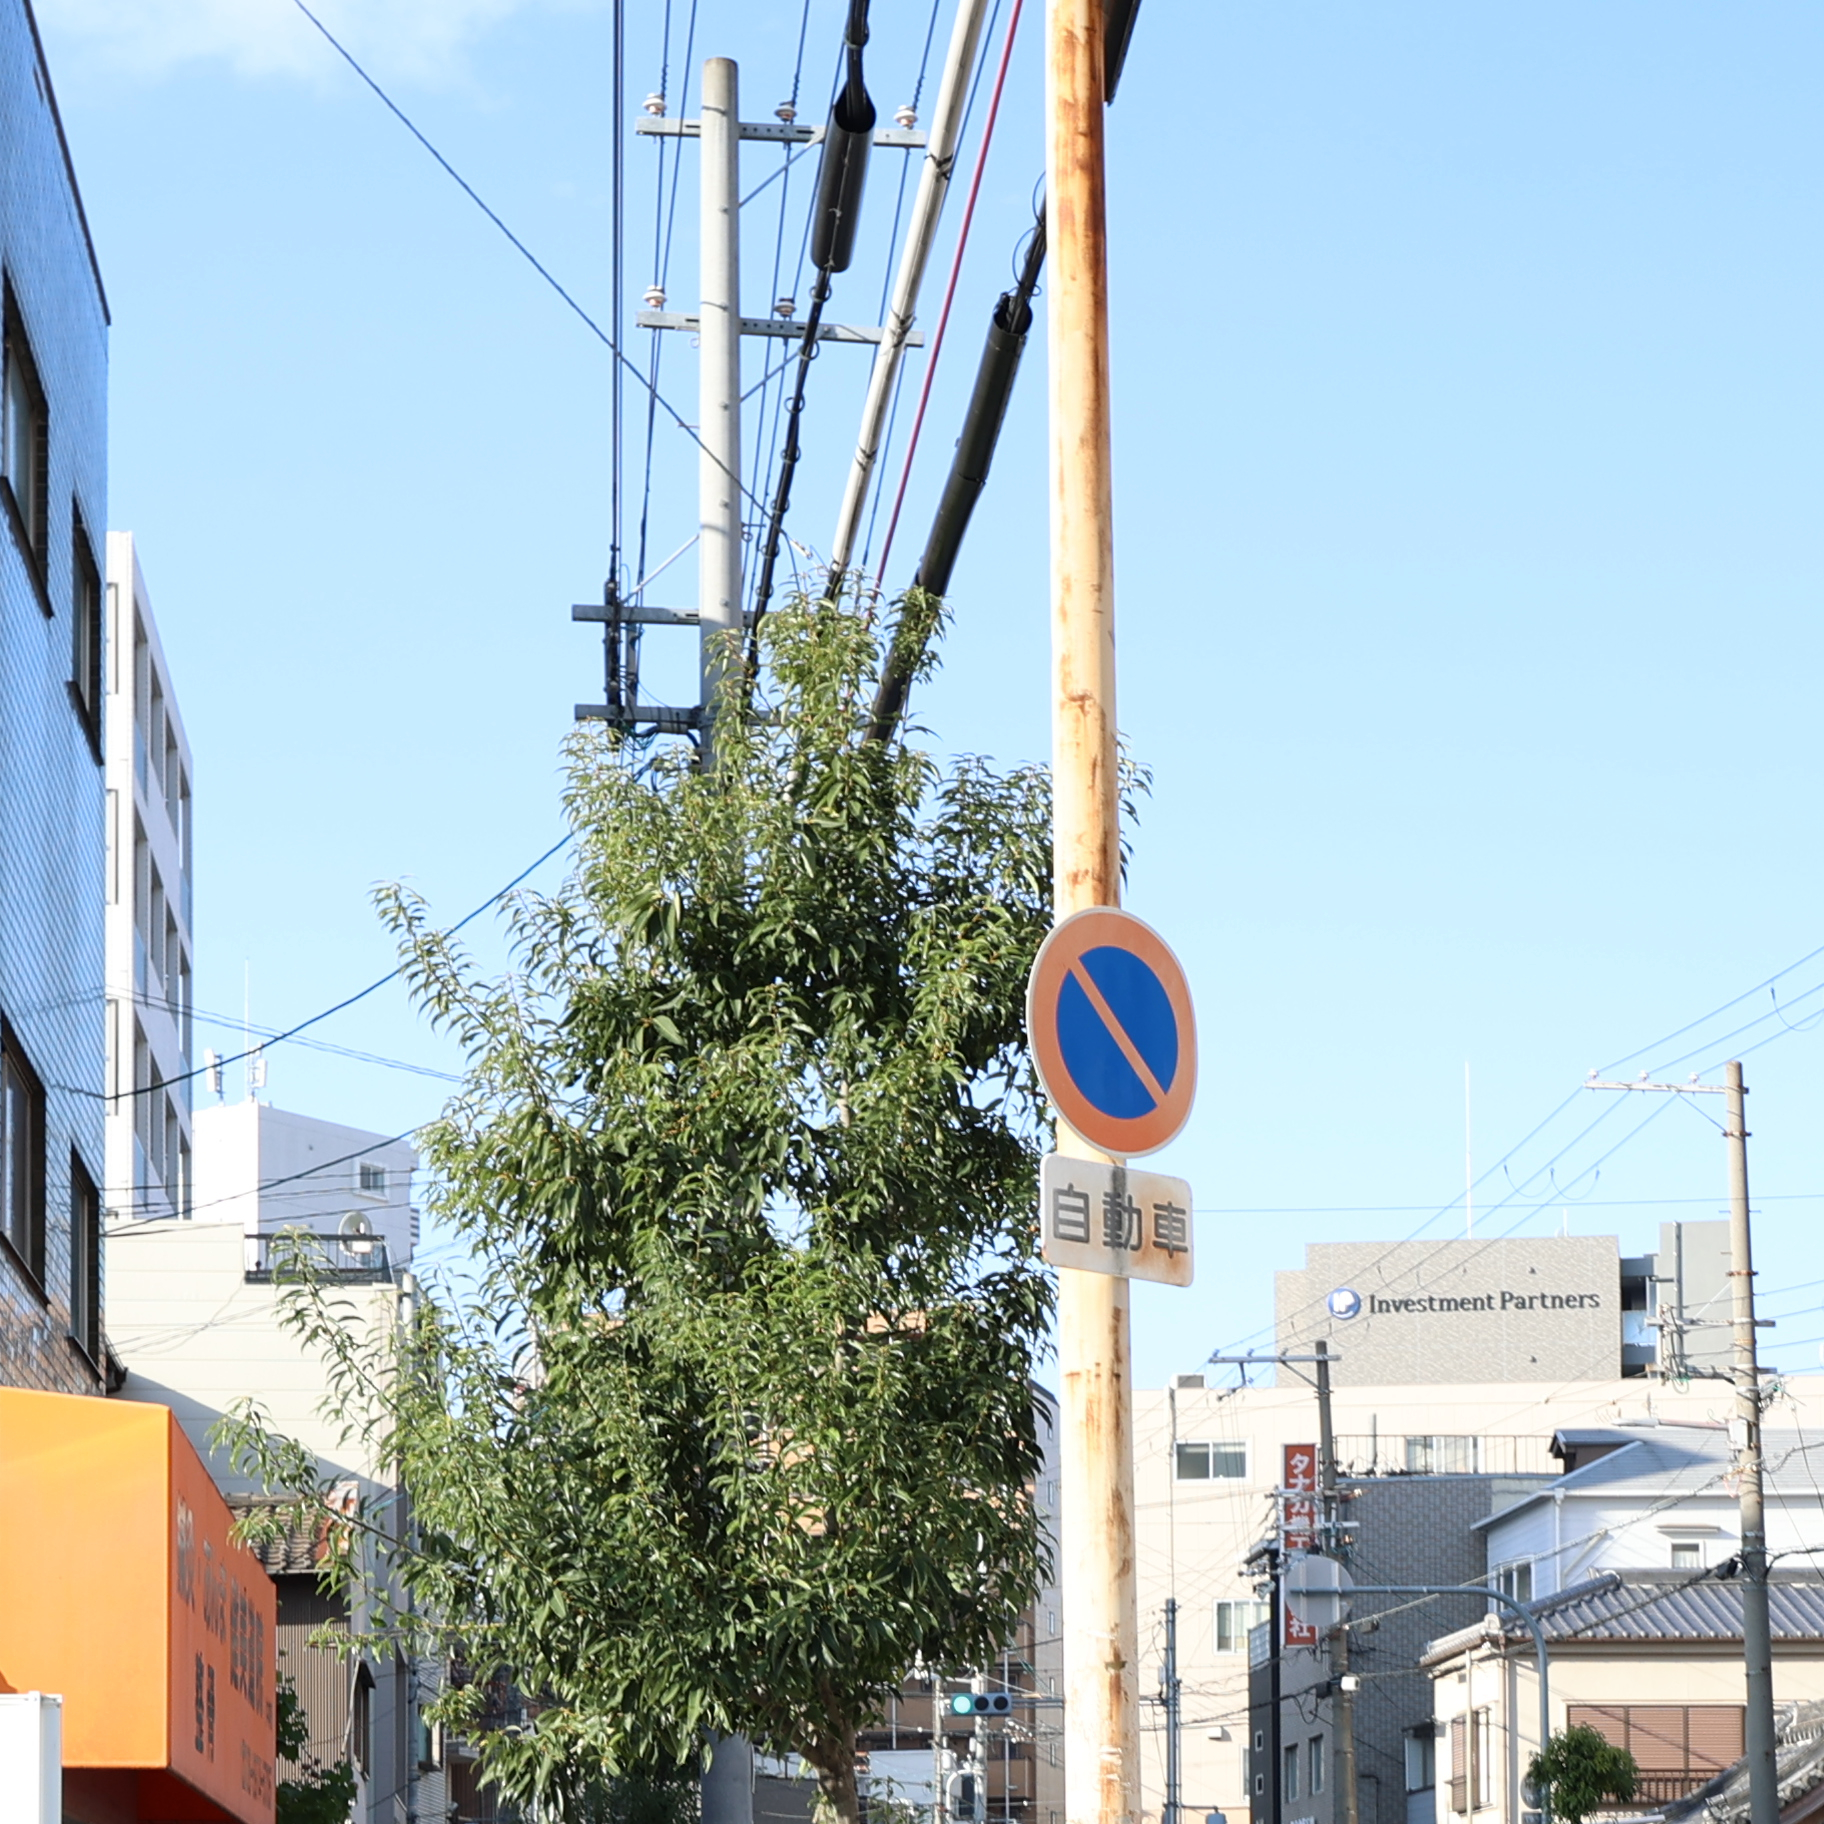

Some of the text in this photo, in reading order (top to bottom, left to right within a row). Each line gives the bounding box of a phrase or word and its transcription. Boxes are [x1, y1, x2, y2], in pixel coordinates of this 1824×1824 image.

[1052, 1183, 1189, 1258] 自動車
[1370, 1290, 1601, 1313] Investment Partners
